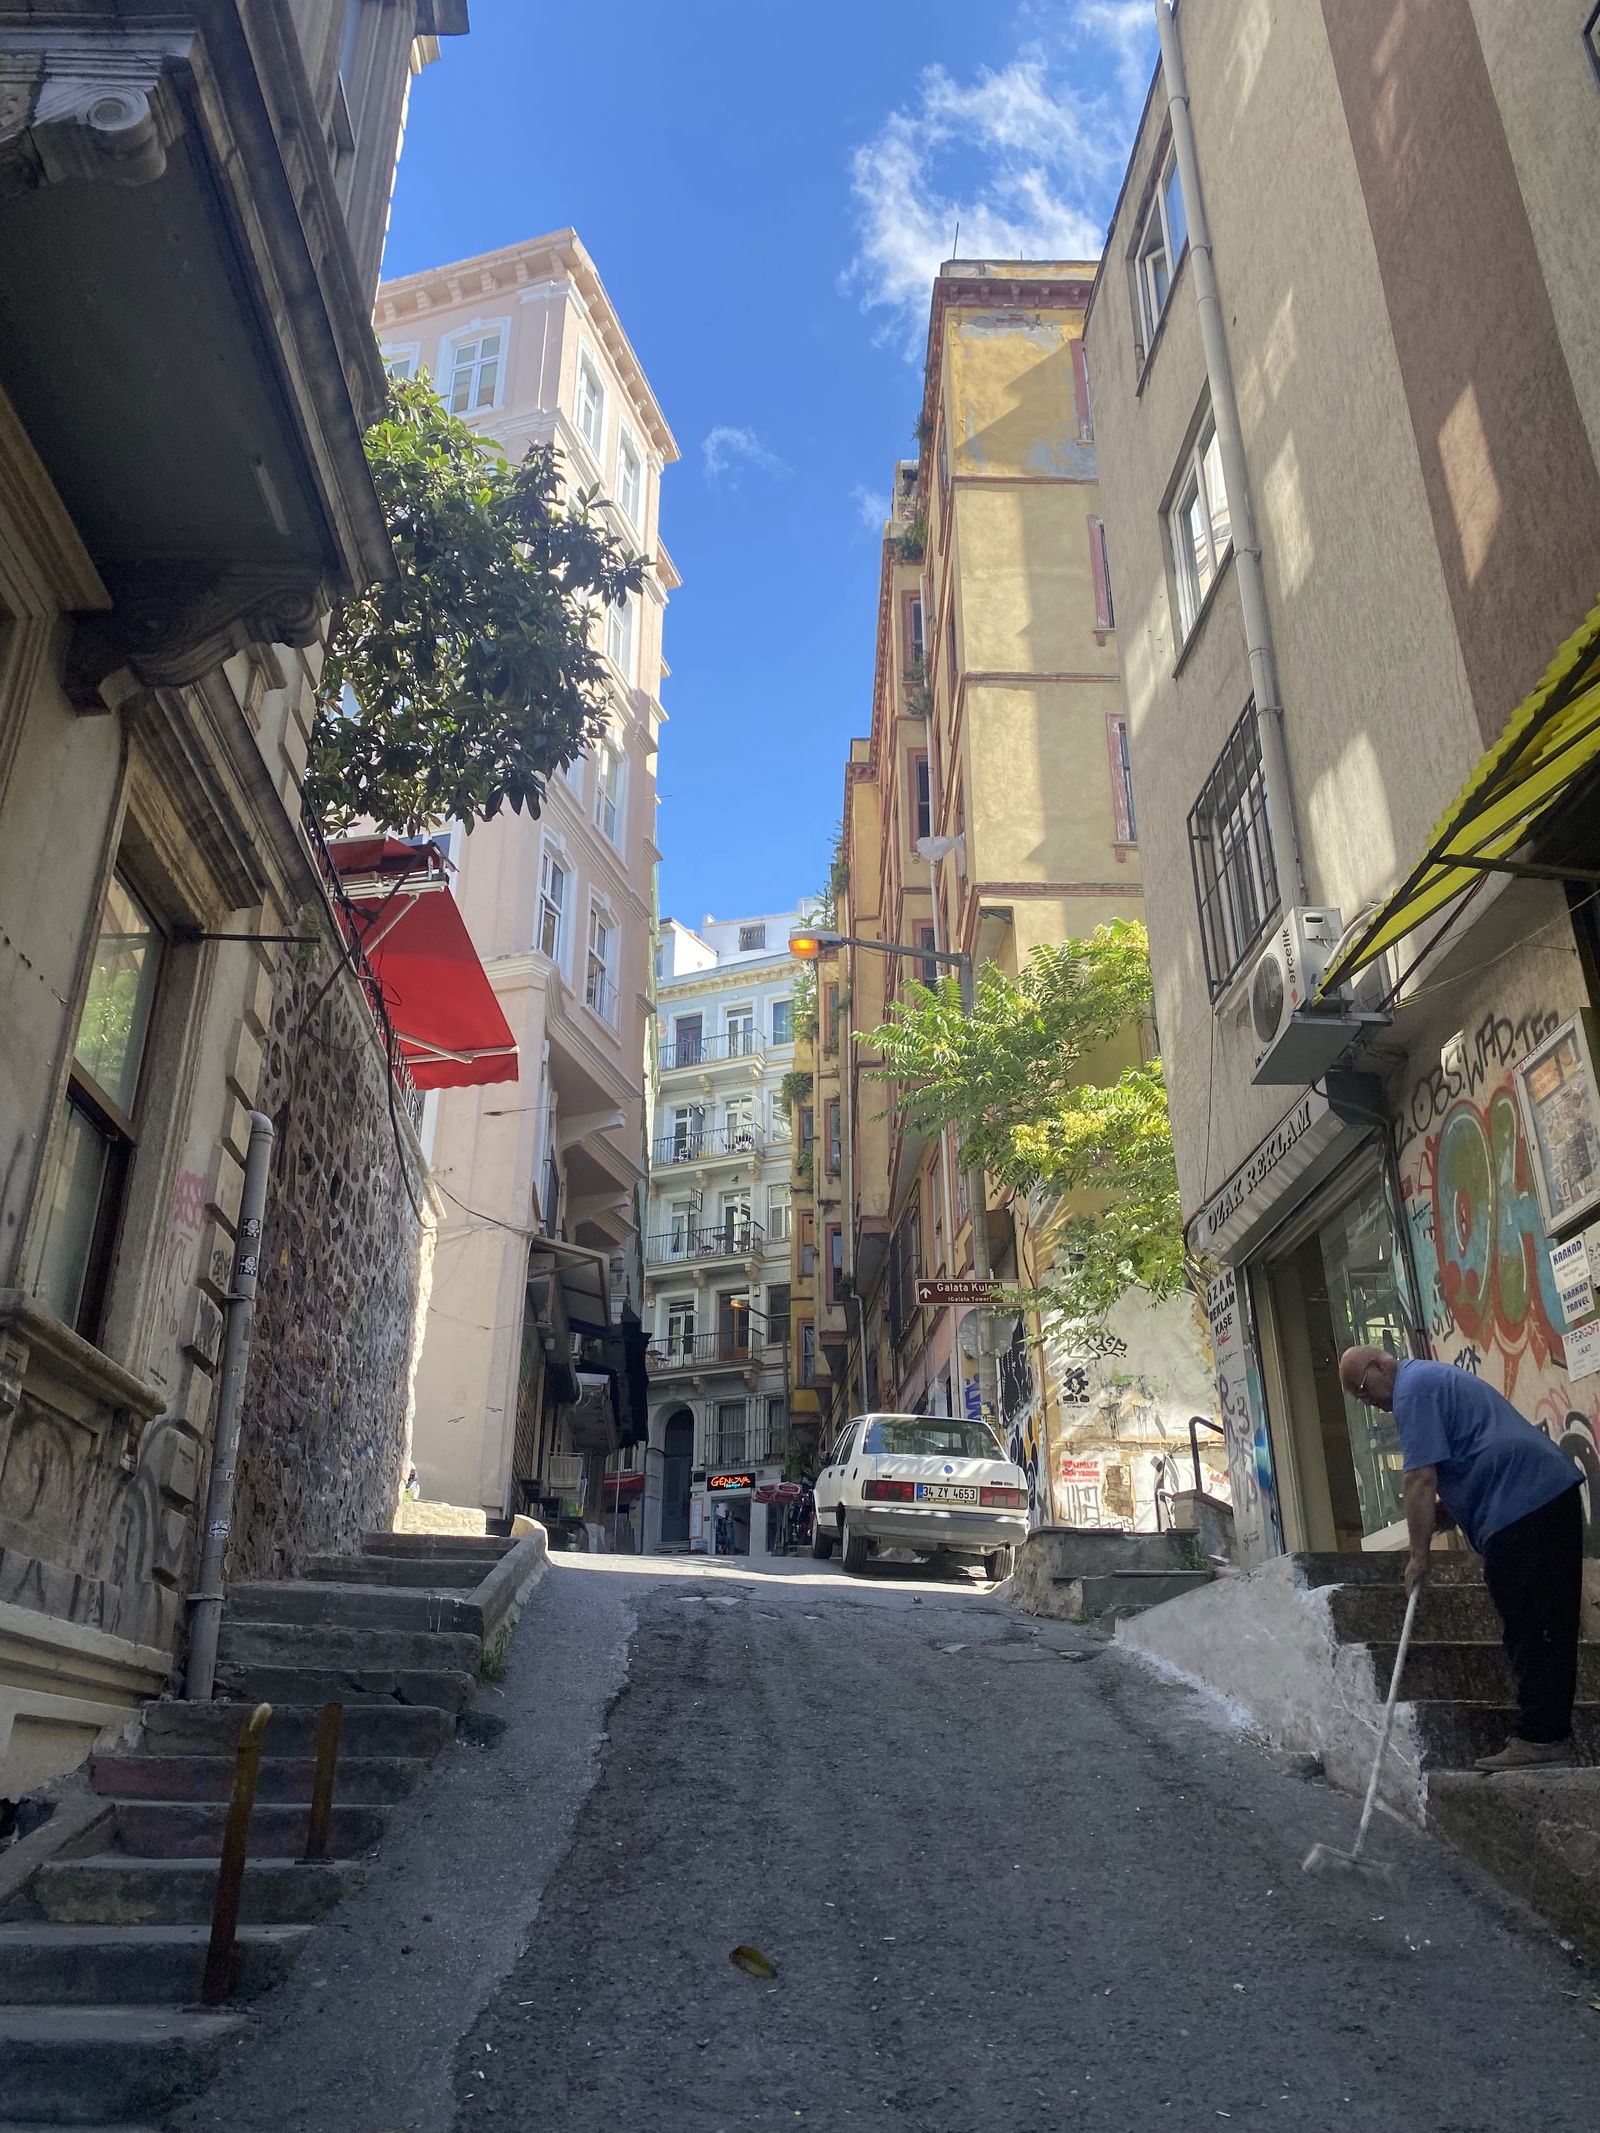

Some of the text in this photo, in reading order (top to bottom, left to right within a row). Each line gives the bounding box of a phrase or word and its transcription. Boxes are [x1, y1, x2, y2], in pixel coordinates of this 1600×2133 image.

[1247, 1100, 1312, 1195] REKLAM
[936, 1283, 969, 1292] Galata
[1209, 1290, 1236, 1324] REKLAM
[1566, 1295, 1590, 1314] TRAVEL
[922, 1486, 975, 1500] 34 ZY 4653
